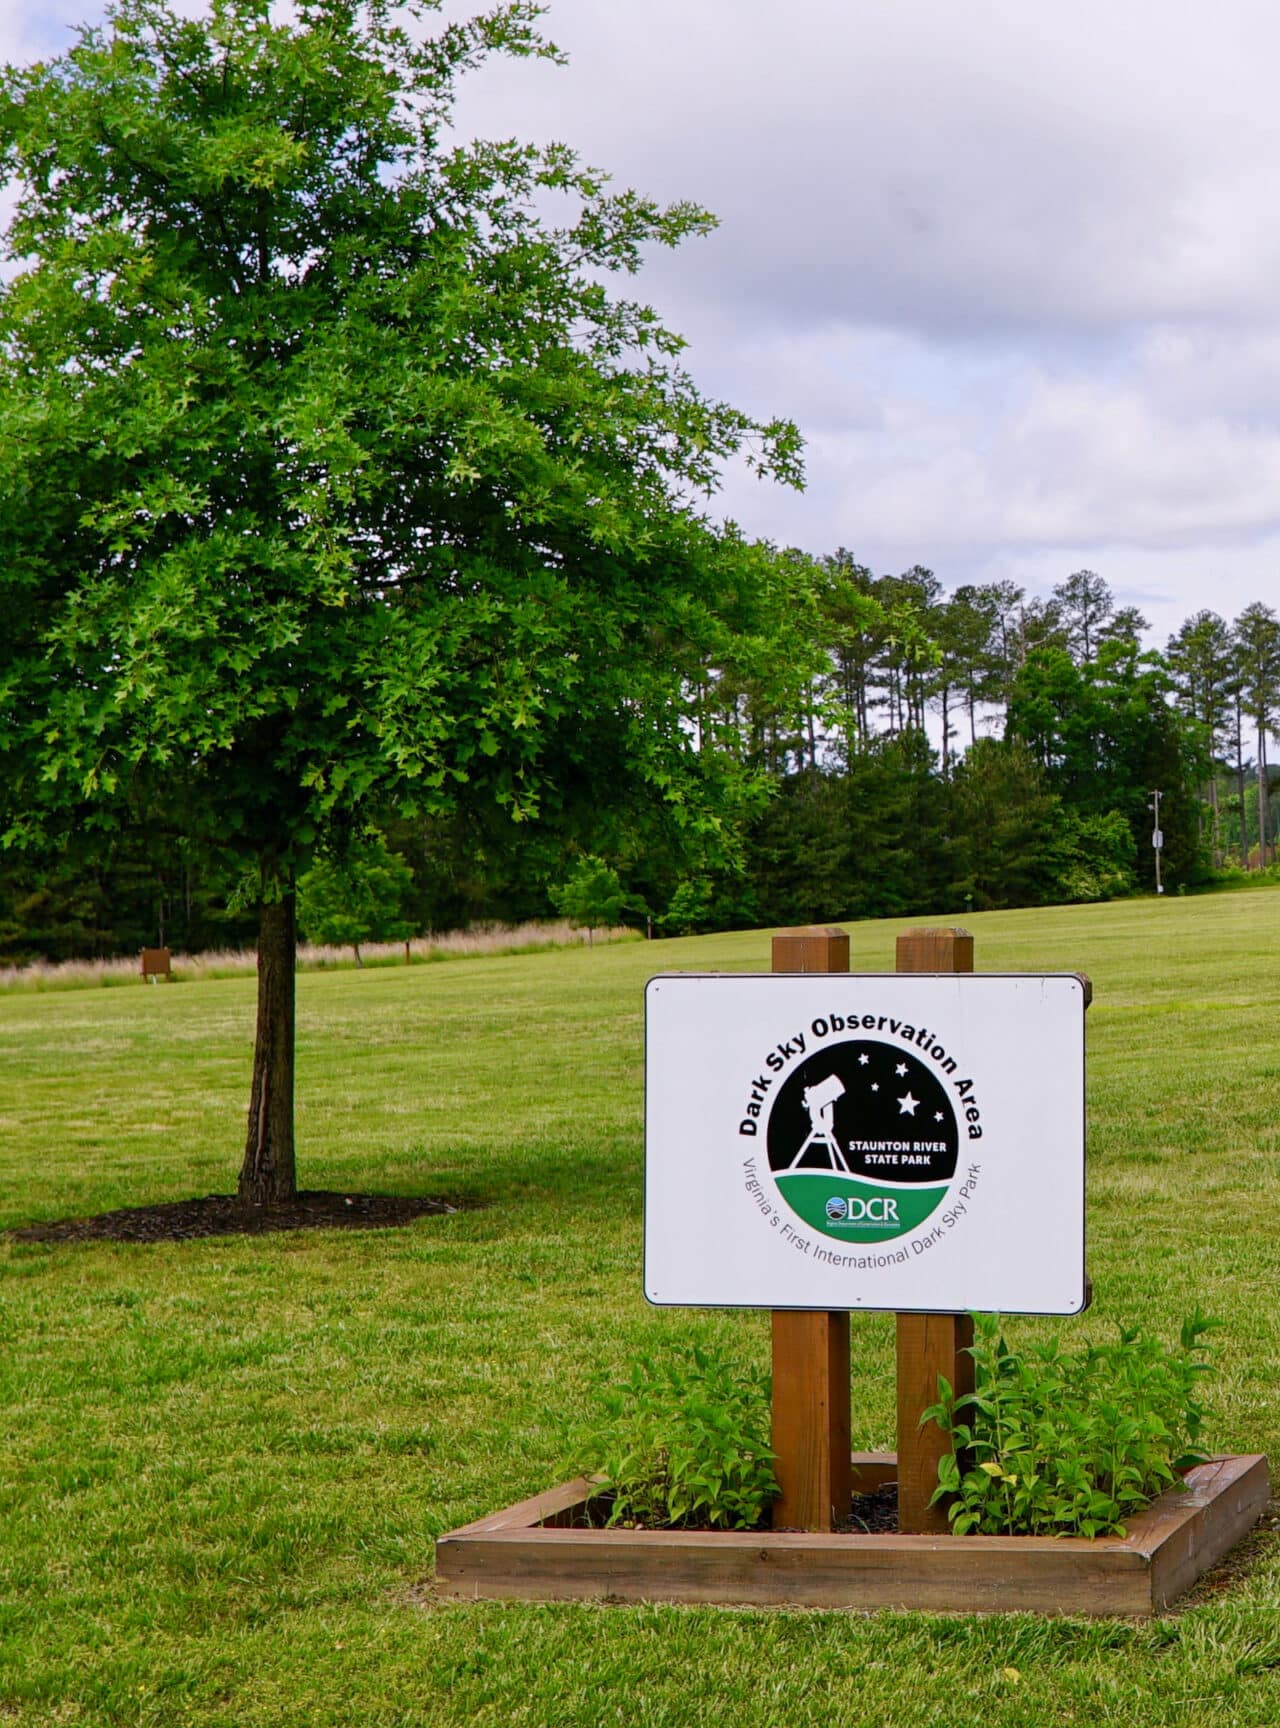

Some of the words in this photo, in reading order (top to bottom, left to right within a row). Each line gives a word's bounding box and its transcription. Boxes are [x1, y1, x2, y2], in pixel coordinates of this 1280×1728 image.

[739, 1075, 773, 1137] Dark
[765, 1032, 807, 1072] Sky
[811, 1014, 958, 1074] Observation
[954, 1078, 983, 1140] Area
[849, 1140, 910, 1152] STAUNTON
[913, 1142, 947, 1152] RIVER
[865, 1154, 898, 1165] STATE
[902, 1154, 931, 1165] PARK
[743, 1157, 780, 1227] Virginia's
[780, 1224, 810, 1253] First
[813, 1245, 909, 1269] International
[911, 1225, 946, 1255] Dark
[942, 1200, 968, 1235] Sky
[959, 1162, 982, 1200] Park
[848, 1198, 899, 1221] DCR
